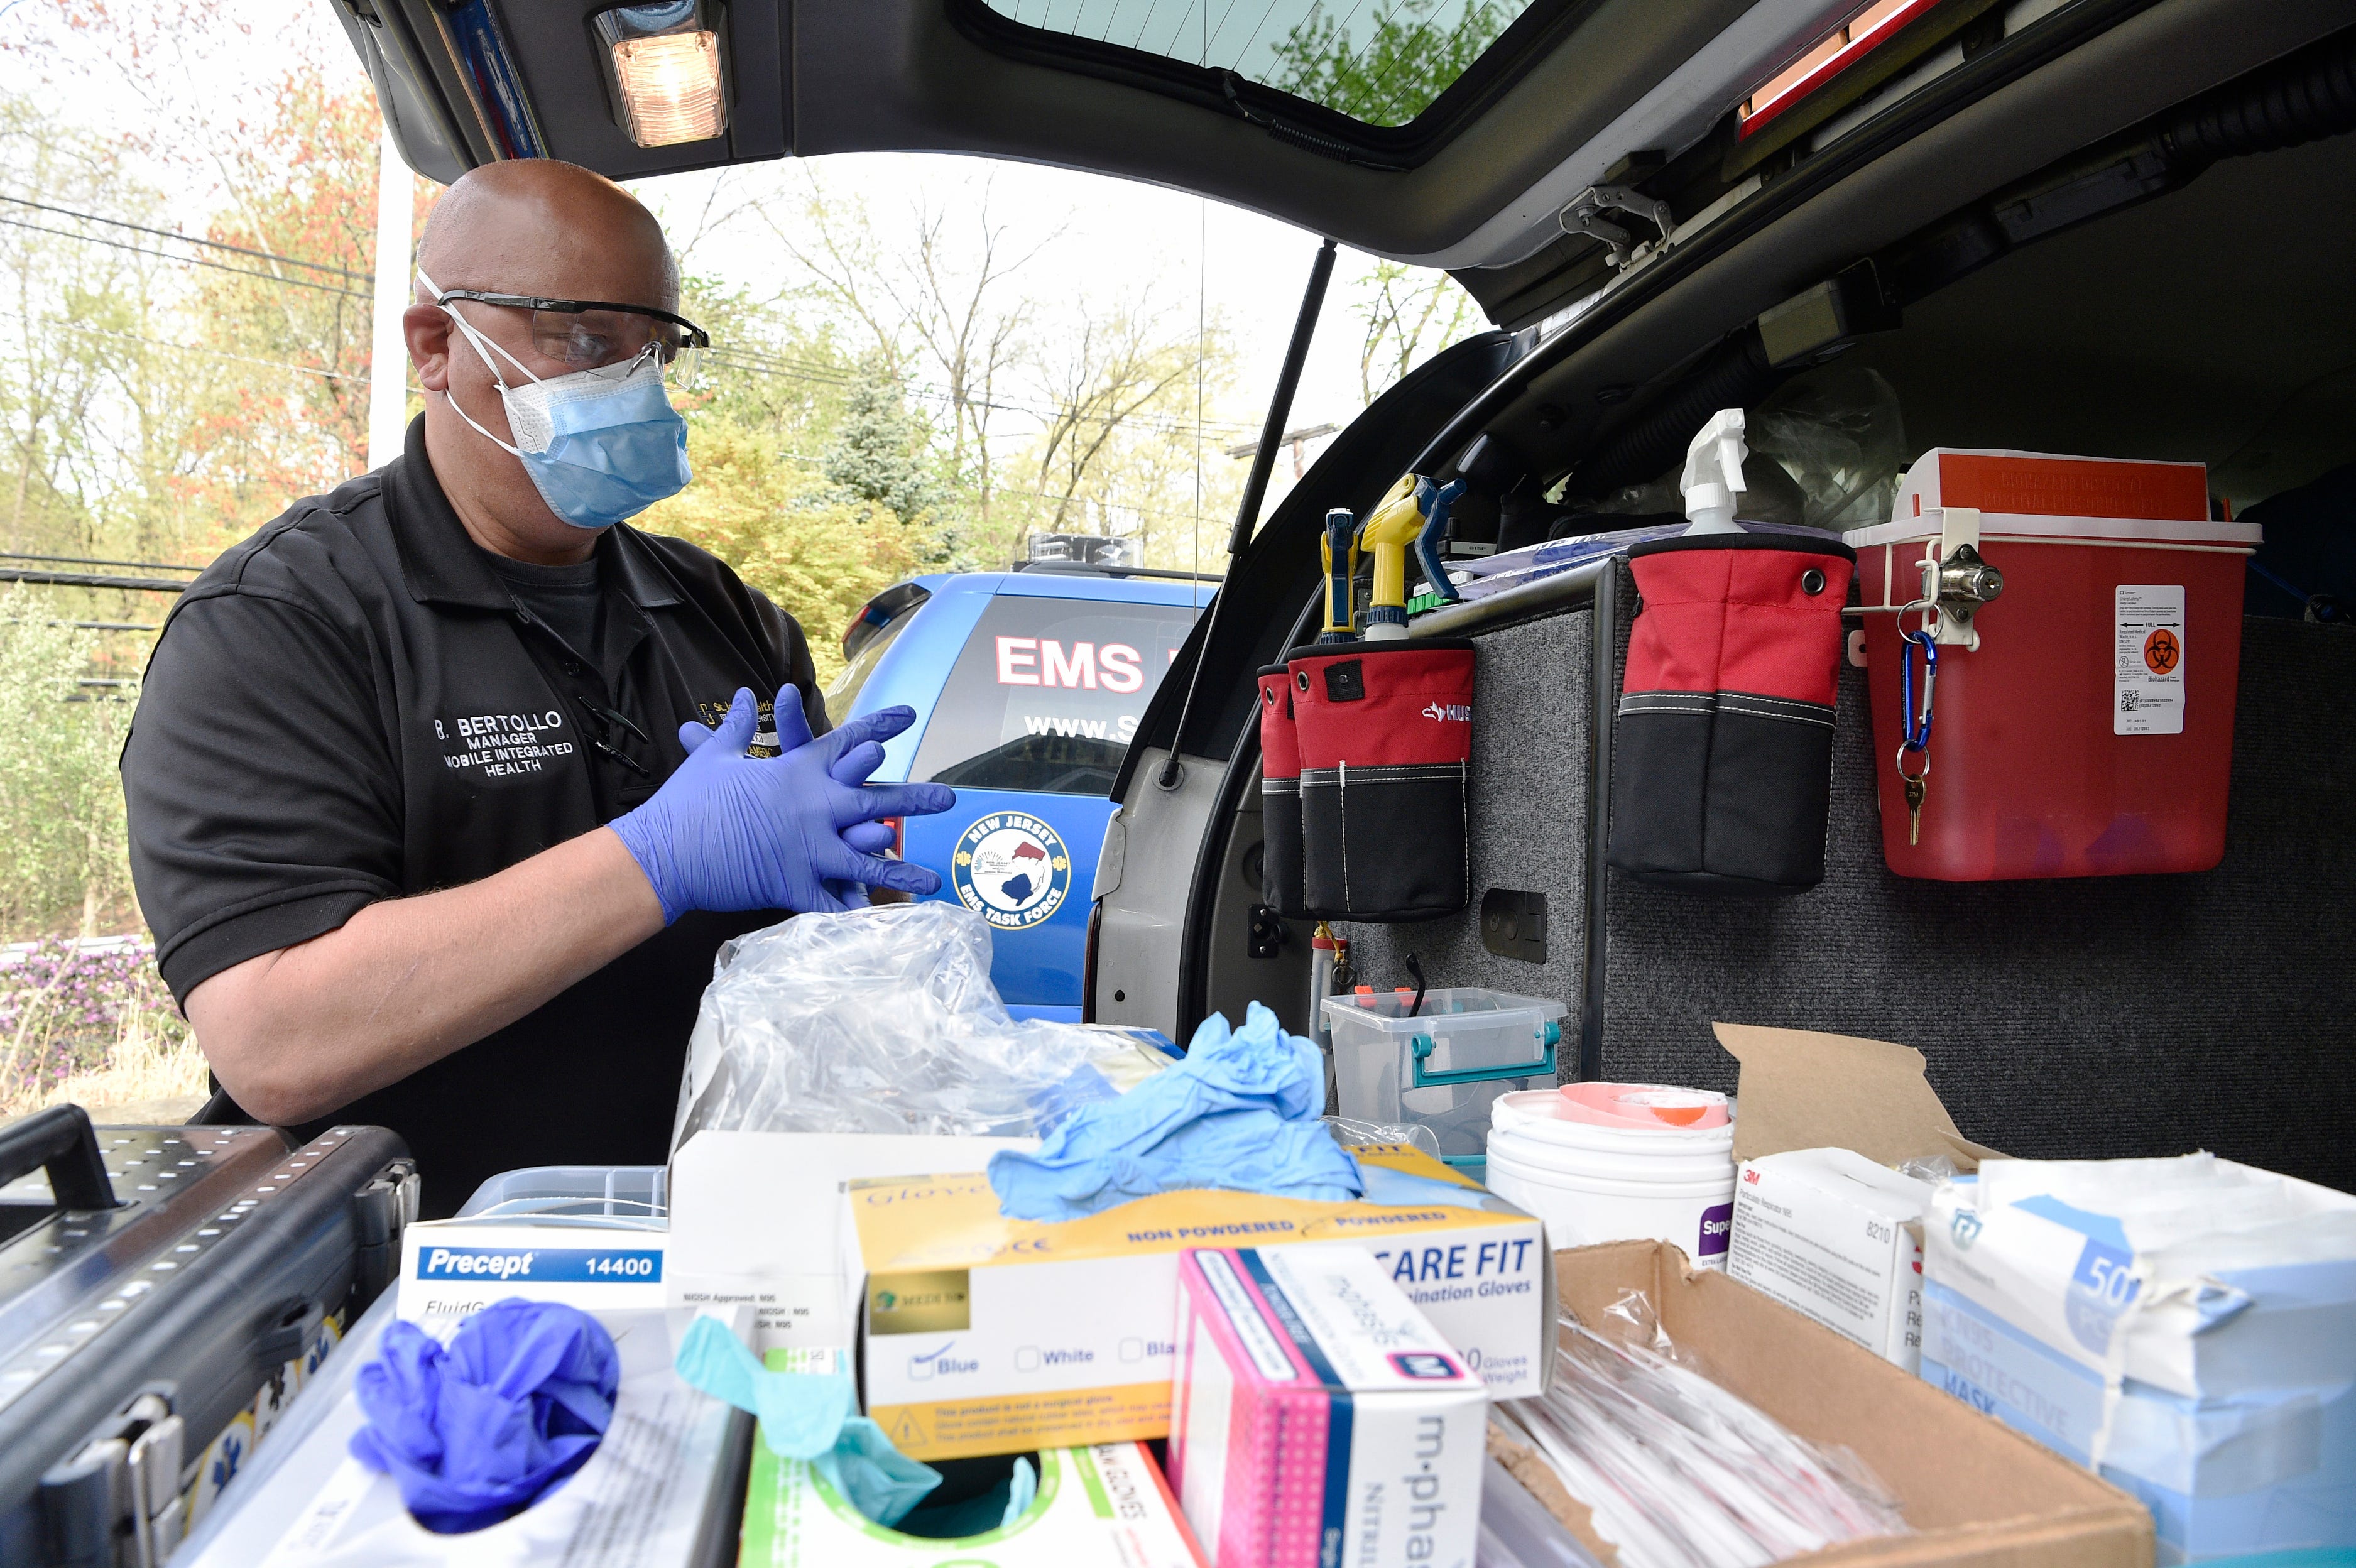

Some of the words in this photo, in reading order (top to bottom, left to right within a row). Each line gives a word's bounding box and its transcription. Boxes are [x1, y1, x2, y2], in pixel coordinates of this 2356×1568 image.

[995, 636, 1145, 694] EMS
[757, 700, 773, 712] alth
[1446, 704, 1471, 721] HUS
[457, 710, 562, 737] BERTOLLO
[1024, 715, 1140, 743] www.S
[466, 732, 538, 750] MANAGER
[746, 746, 773, 758] AMEDIC
[444, 751, 493, 768] MOBILE
[494, 742, 573, 761] INTEGRATED
[484, 759, 542, 778] HEALTH
[968, 817, 1000, 844] NEW
[1005, 815, 1057, 846] JERSEY
[960, 883, 985, 912] EMS
[985, 907, 1022, 926] TASK
[1023, 887, 1062, 923] FORCE
[1743, 1169, 1761, 1186] 3M
[1335, 1211, 1448, 1227] POWDERED
[1703, 1219, 1731, 1236] Supe
[1126, 1228, 1174, 1243] NON
[1179, 1220, 1295, 1238] POWDERED
[1866, 1221, 1890, 1245] 8210
[427, 1249, 533, 1279] Precept
[586, 1258, 653, 1276] 14400
[1375, 1244, 1467, 1282] ARE
[1476, 1238, 1533, 1277] FIT
[1409, 1286, 1473, 1305] ination
[1478, 1280, 1532, 1298] Gloves
[2084, 1256, 2130, 1307] 50
[1043, 1347, 1094, 1366] White
[1147, 1339, 1174, 1356] Bla
[937, 1357, 979, 1375] Blue
[1483, 1355, 1528, 1368] Gloves
[1941, 1337, 2070, 1437] PROTECTIVE
[1943, 1364, 1997, 1417] MASK
